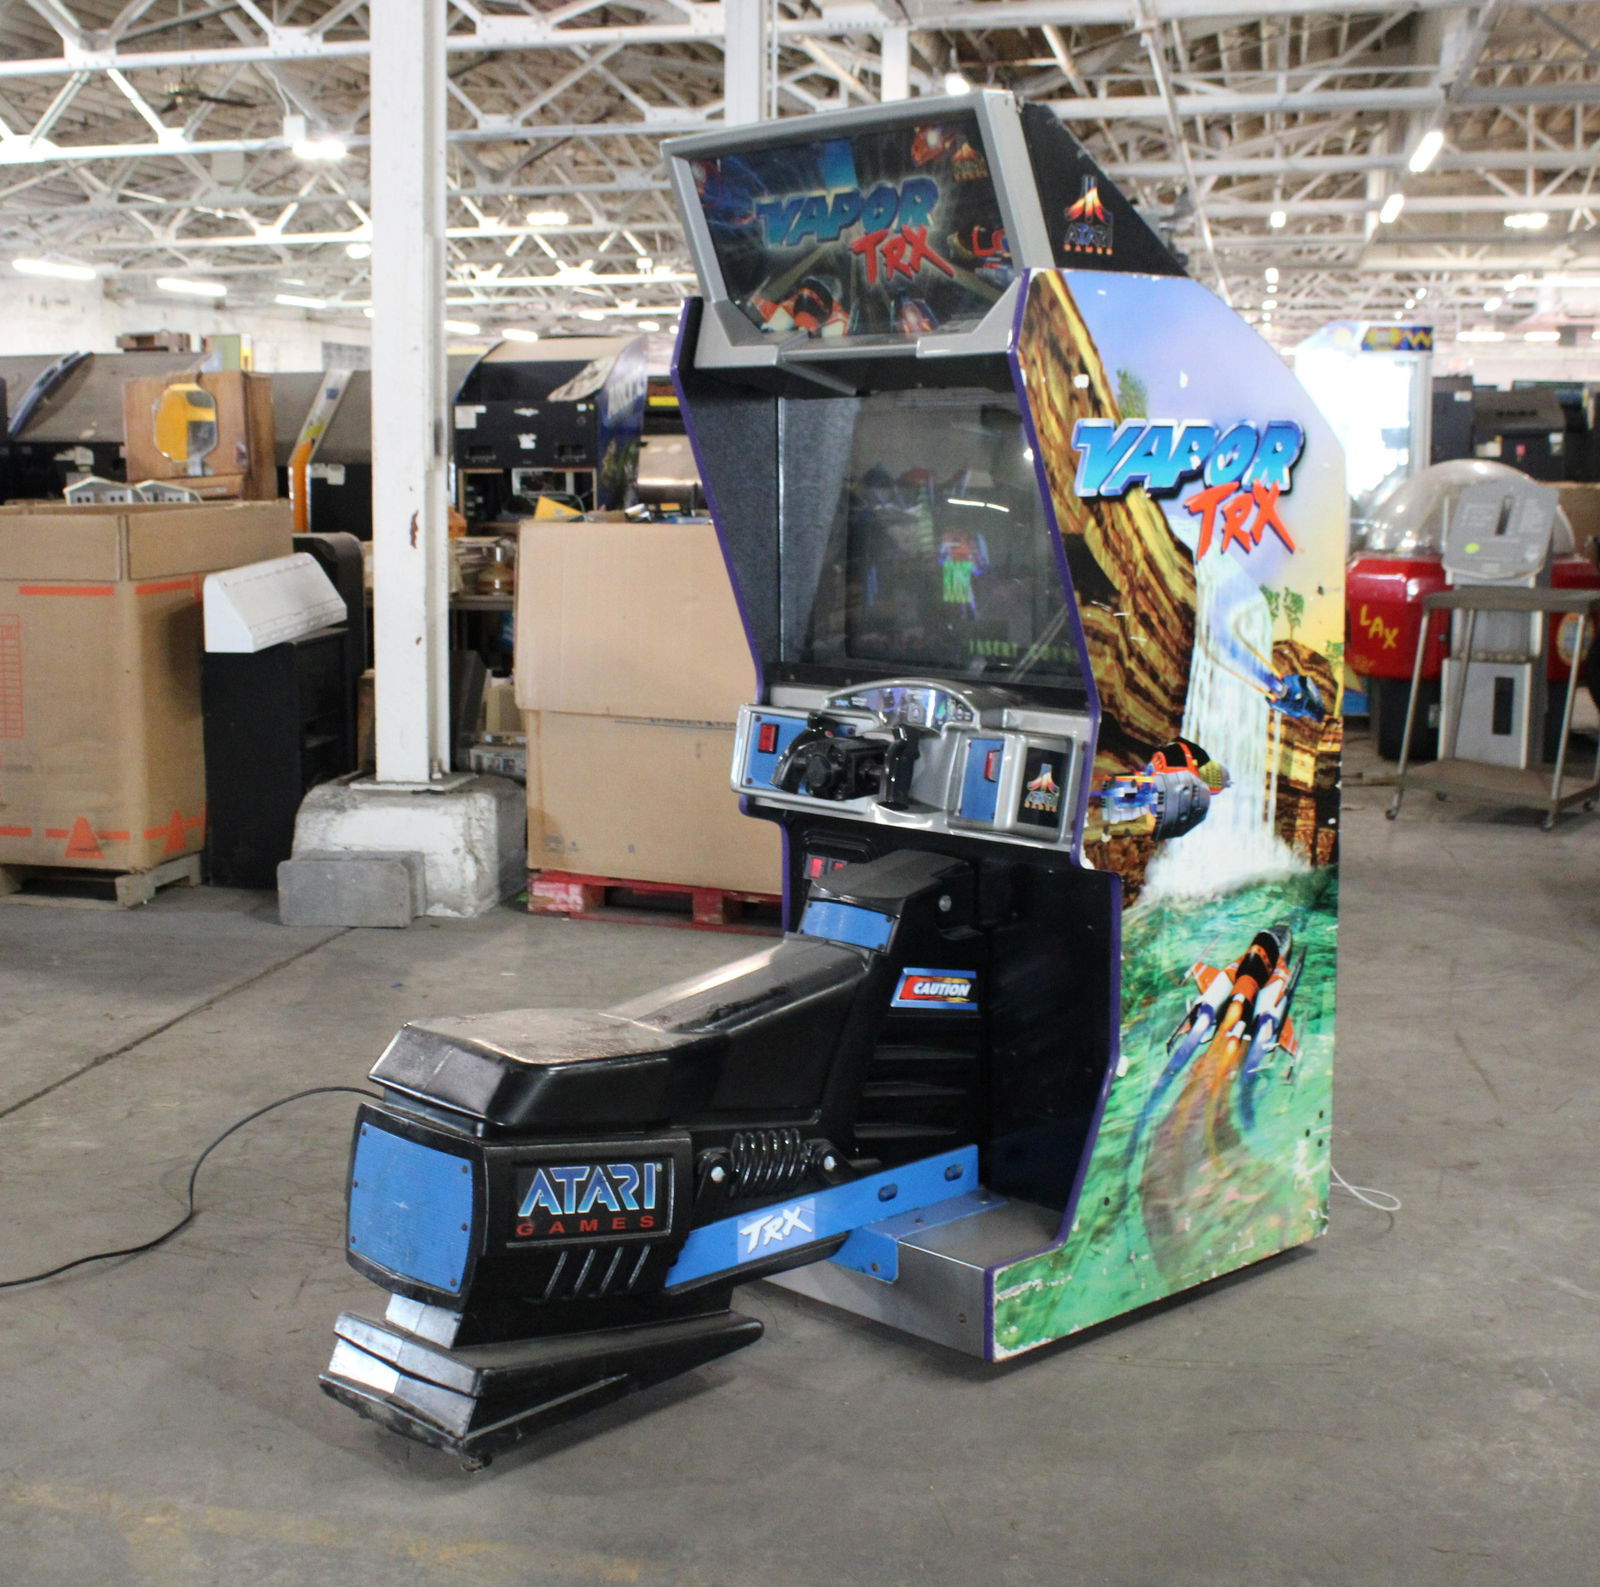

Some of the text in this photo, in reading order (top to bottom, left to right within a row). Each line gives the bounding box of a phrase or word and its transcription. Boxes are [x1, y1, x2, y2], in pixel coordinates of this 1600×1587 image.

[753, 175, 939, 249] VAPOR
[849, 224, 955, 285] TRX
[1071, 417, 1307, 500] VAPOR
[1183, 477, 1297, 564] TRX
[1359, 604, 1399, 650] LAX
[912, 981, 972, 997] CAUTION
[517, 1162, 657, 1217] ATARI
[516, 1215, 655, 1237] GAMES
[739, 1206, 814, 1255] TRX
